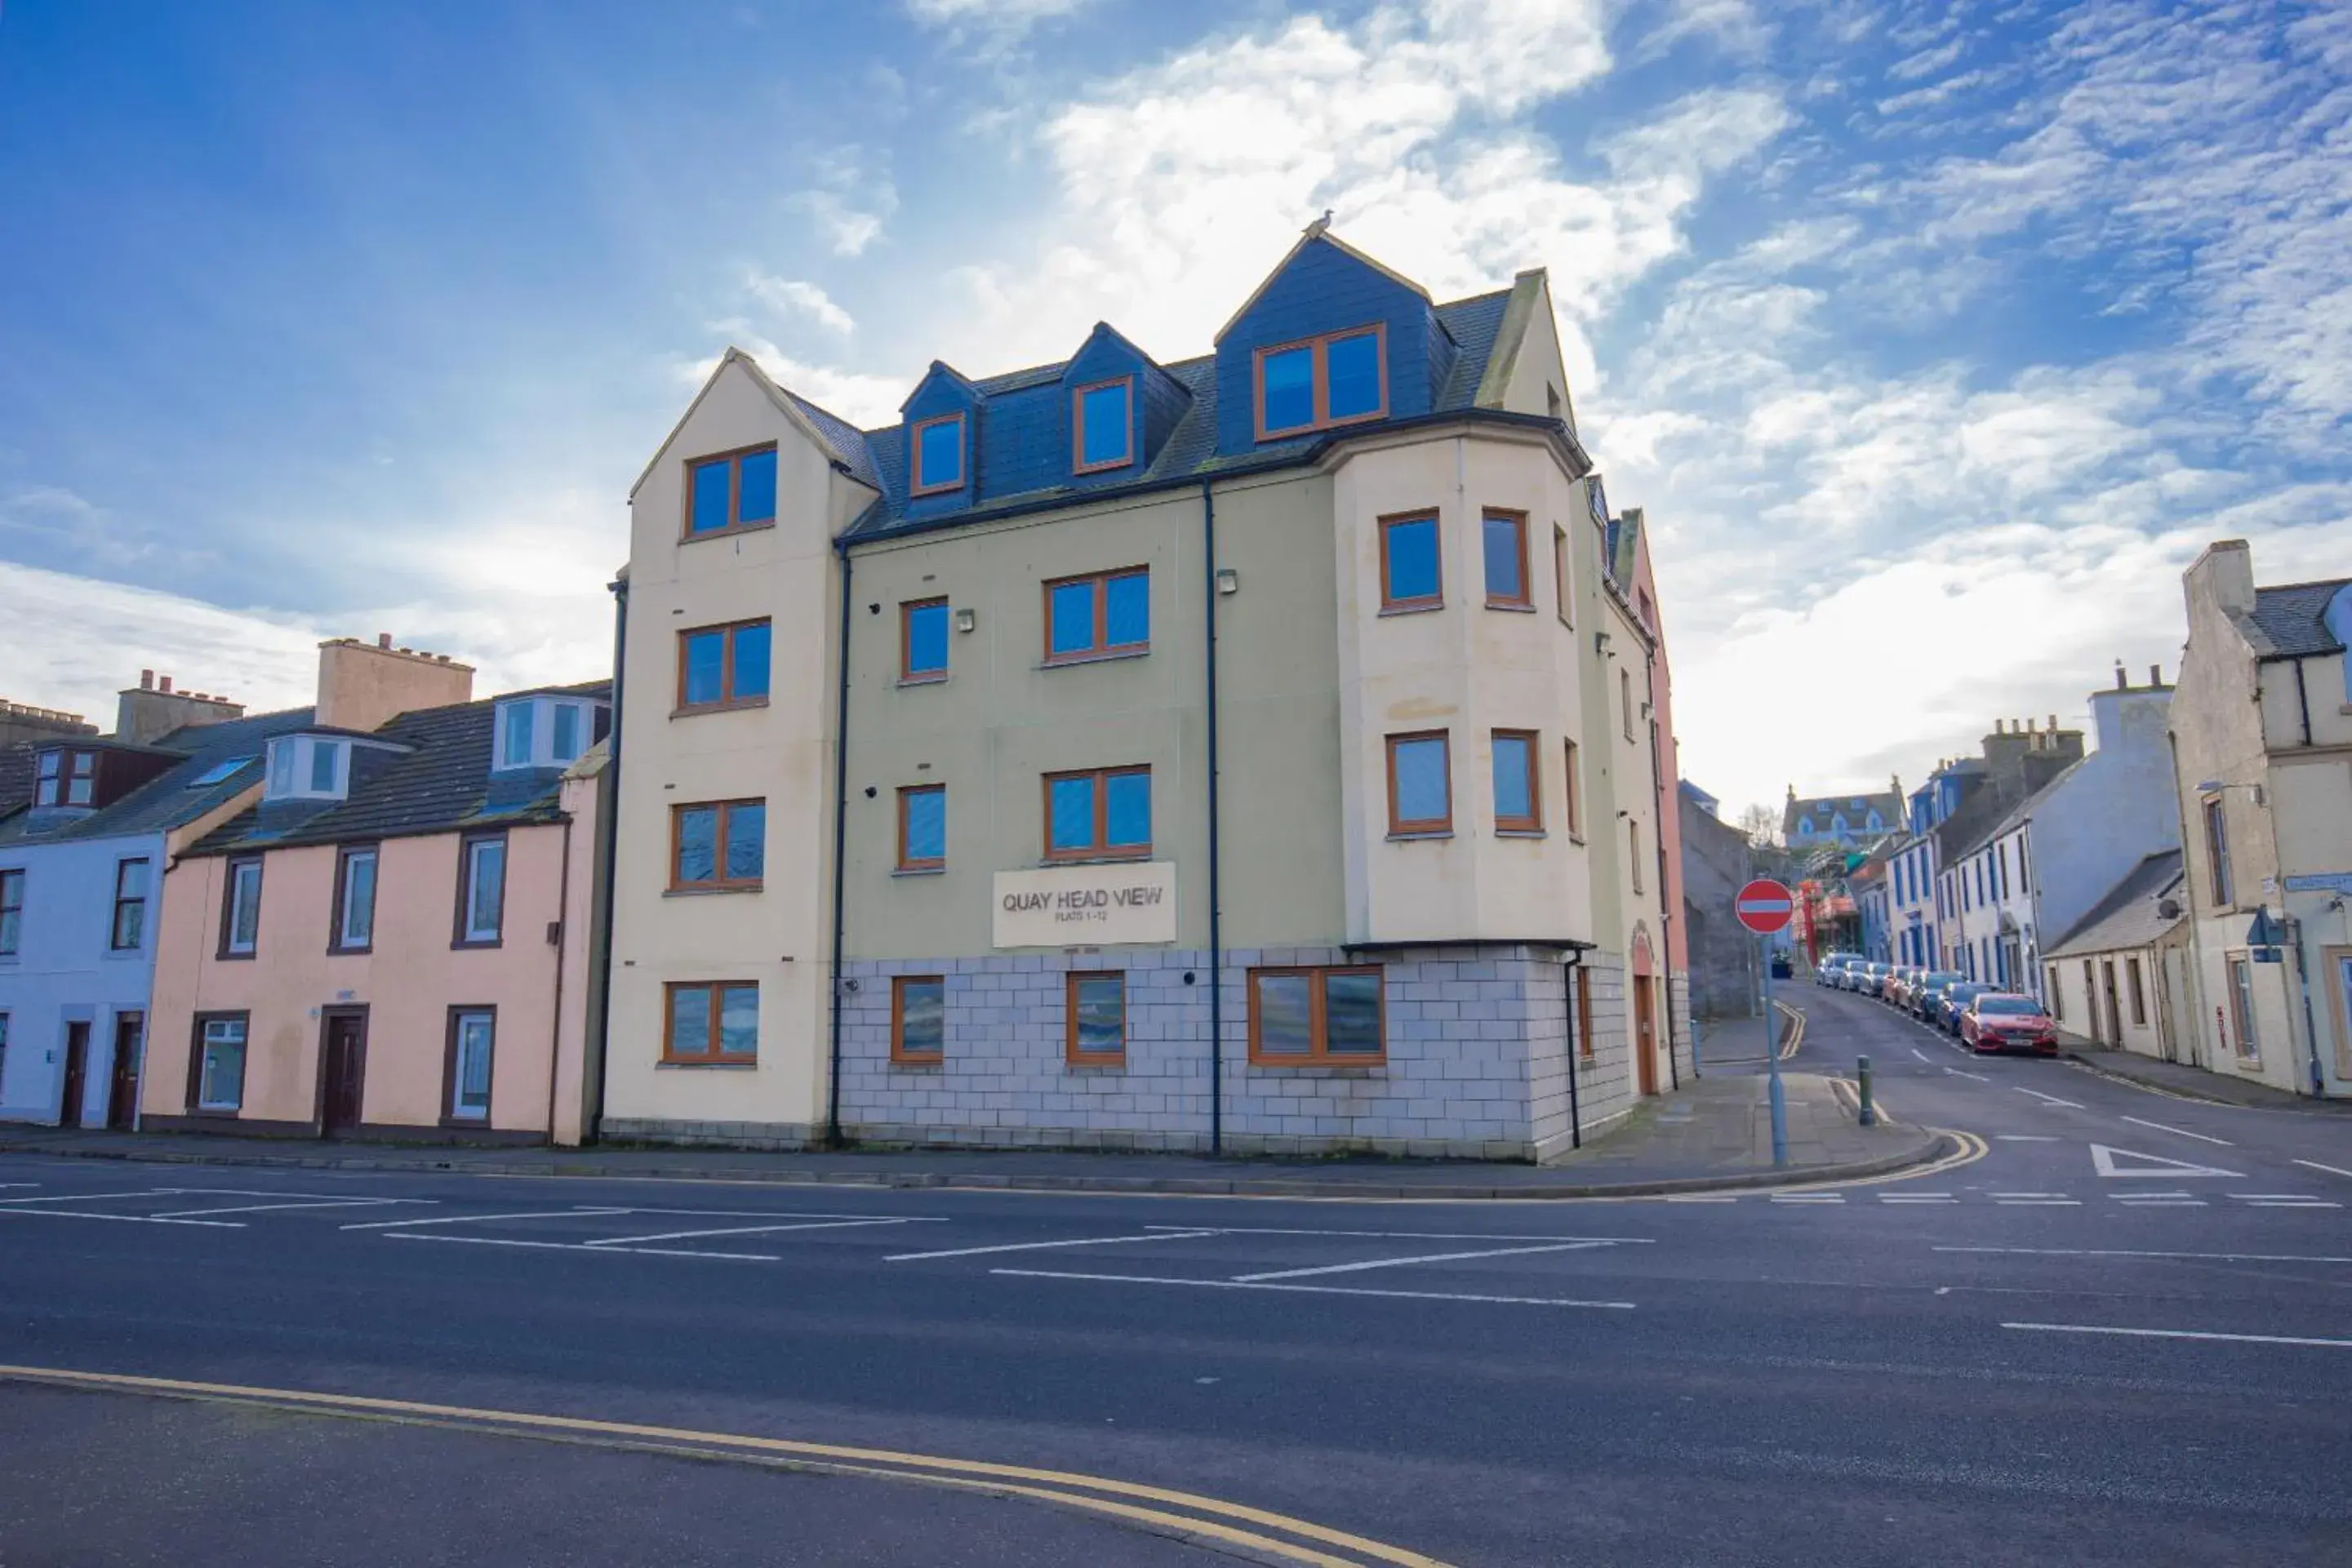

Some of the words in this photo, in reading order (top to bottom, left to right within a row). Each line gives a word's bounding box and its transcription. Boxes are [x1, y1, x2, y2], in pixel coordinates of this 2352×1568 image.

[1003, 892, 1052, 911] QUAY
[1057, 890, 1108, 908] HEAD
[1113, 886, 1163, 907] VIEW
